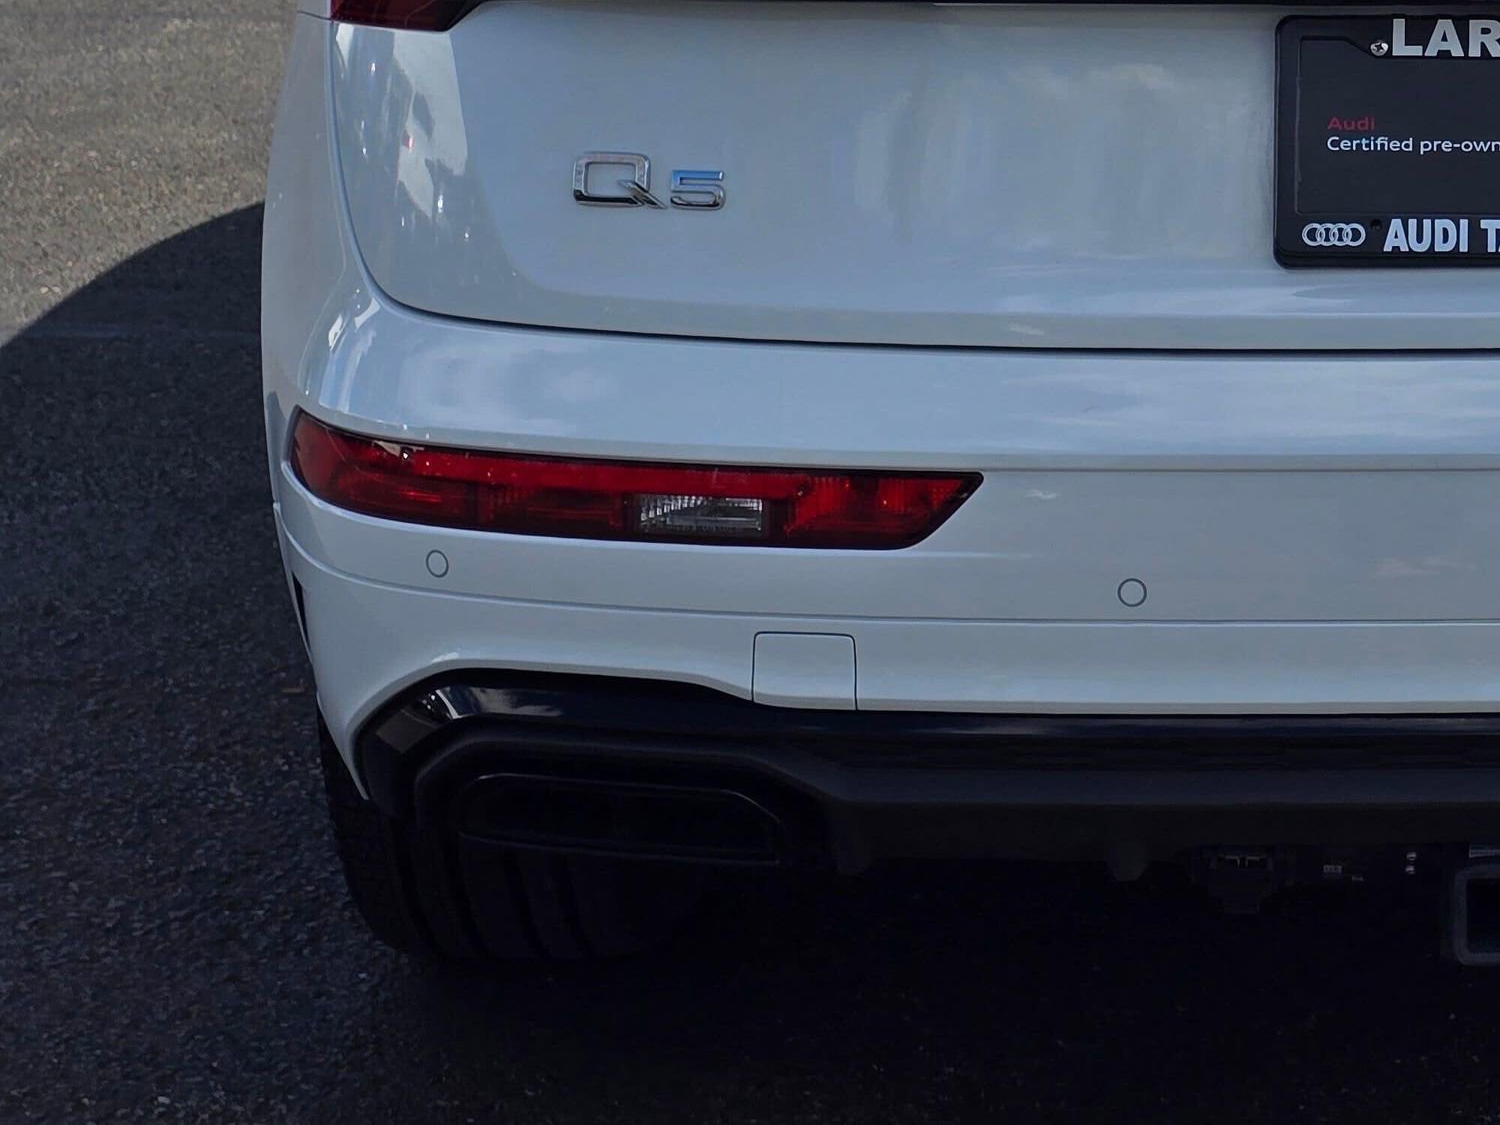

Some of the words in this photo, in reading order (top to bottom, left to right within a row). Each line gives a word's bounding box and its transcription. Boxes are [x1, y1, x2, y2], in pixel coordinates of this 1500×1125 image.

[1327, 116, 1376, 132] Audi
[1327, 135, 1414, 153] Certified
[573, 151, 726, 211] Q5
[1383, 218, 1469, 253] AUDI
